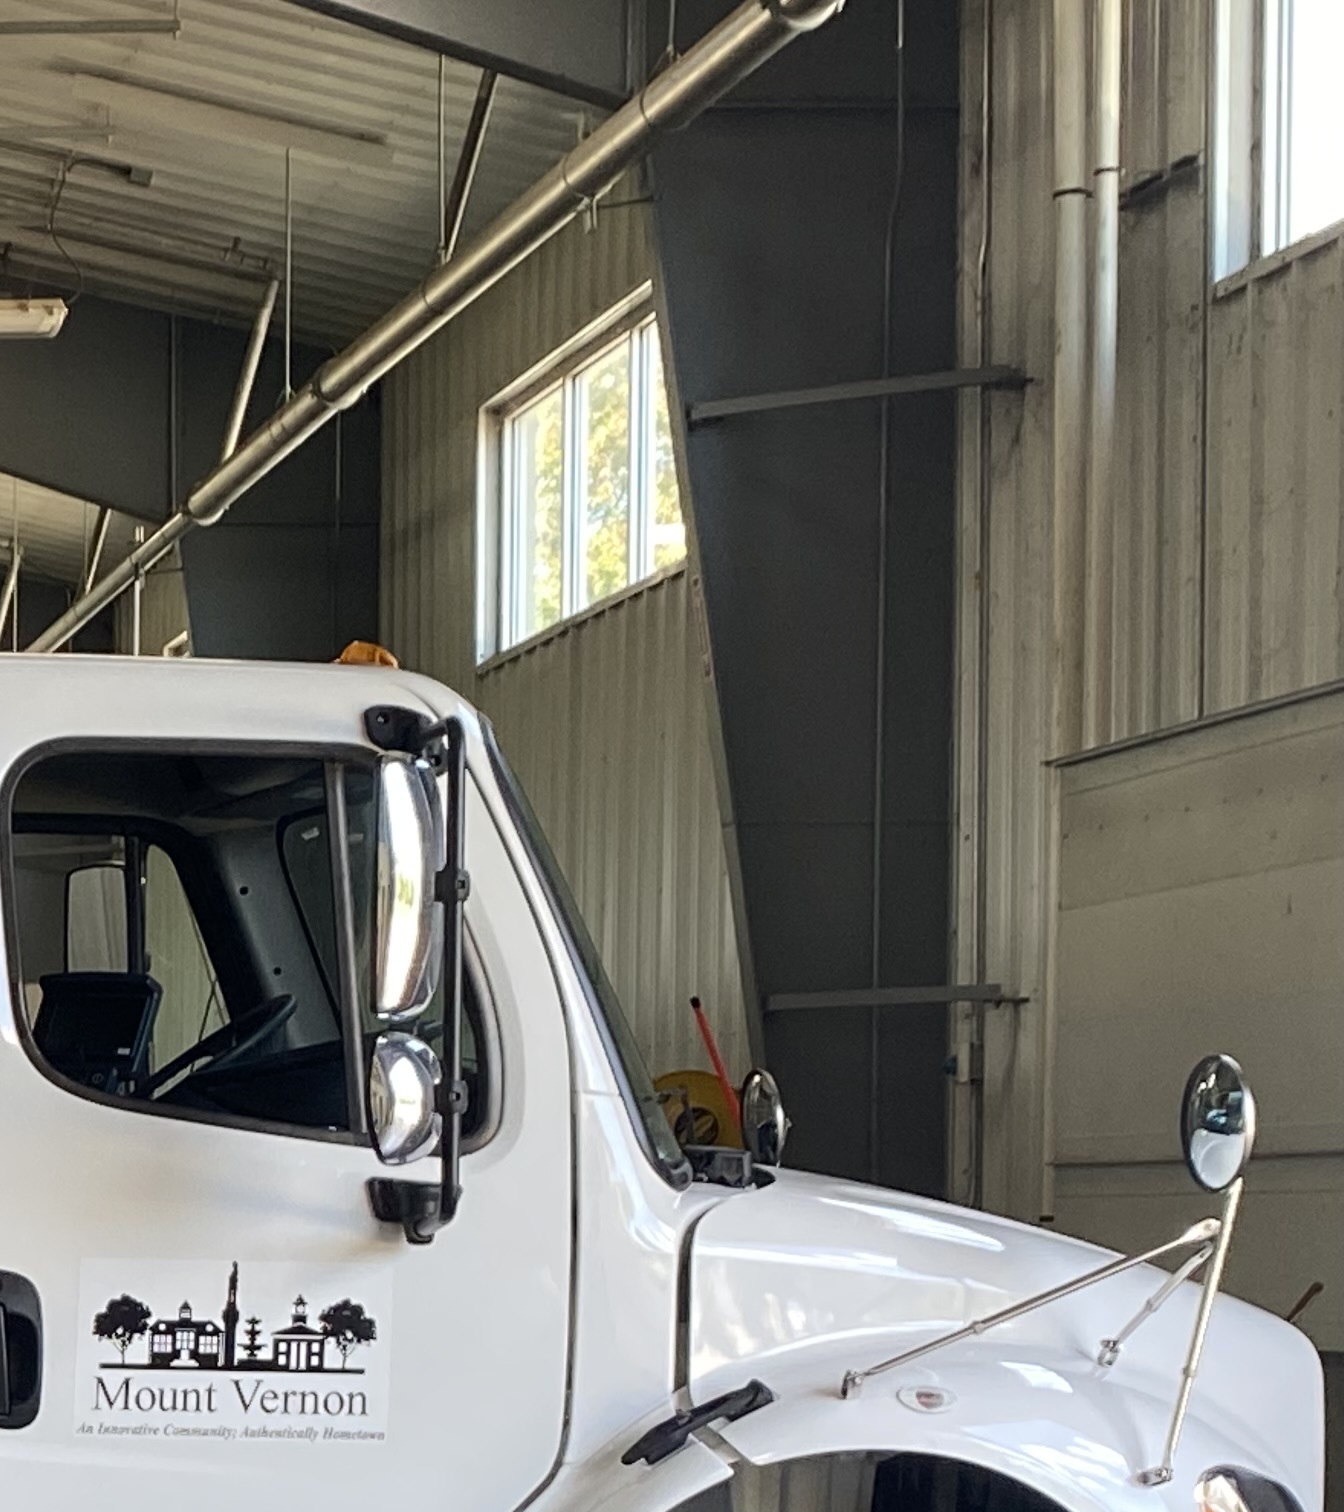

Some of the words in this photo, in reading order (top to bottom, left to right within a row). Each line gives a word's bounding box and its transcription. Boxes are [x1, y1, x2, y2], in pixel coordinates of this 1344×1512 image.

[93, 1376, 217, 1412] Mount
[230, 1378, 369, 1416] Vernon
[76, 1422, 94, 1434] An
[97, 1422, 160, 1436] Innovative
[240, 1425, 318, 1442] Authentically
[323, 1427, 385, 1441] Hometown
